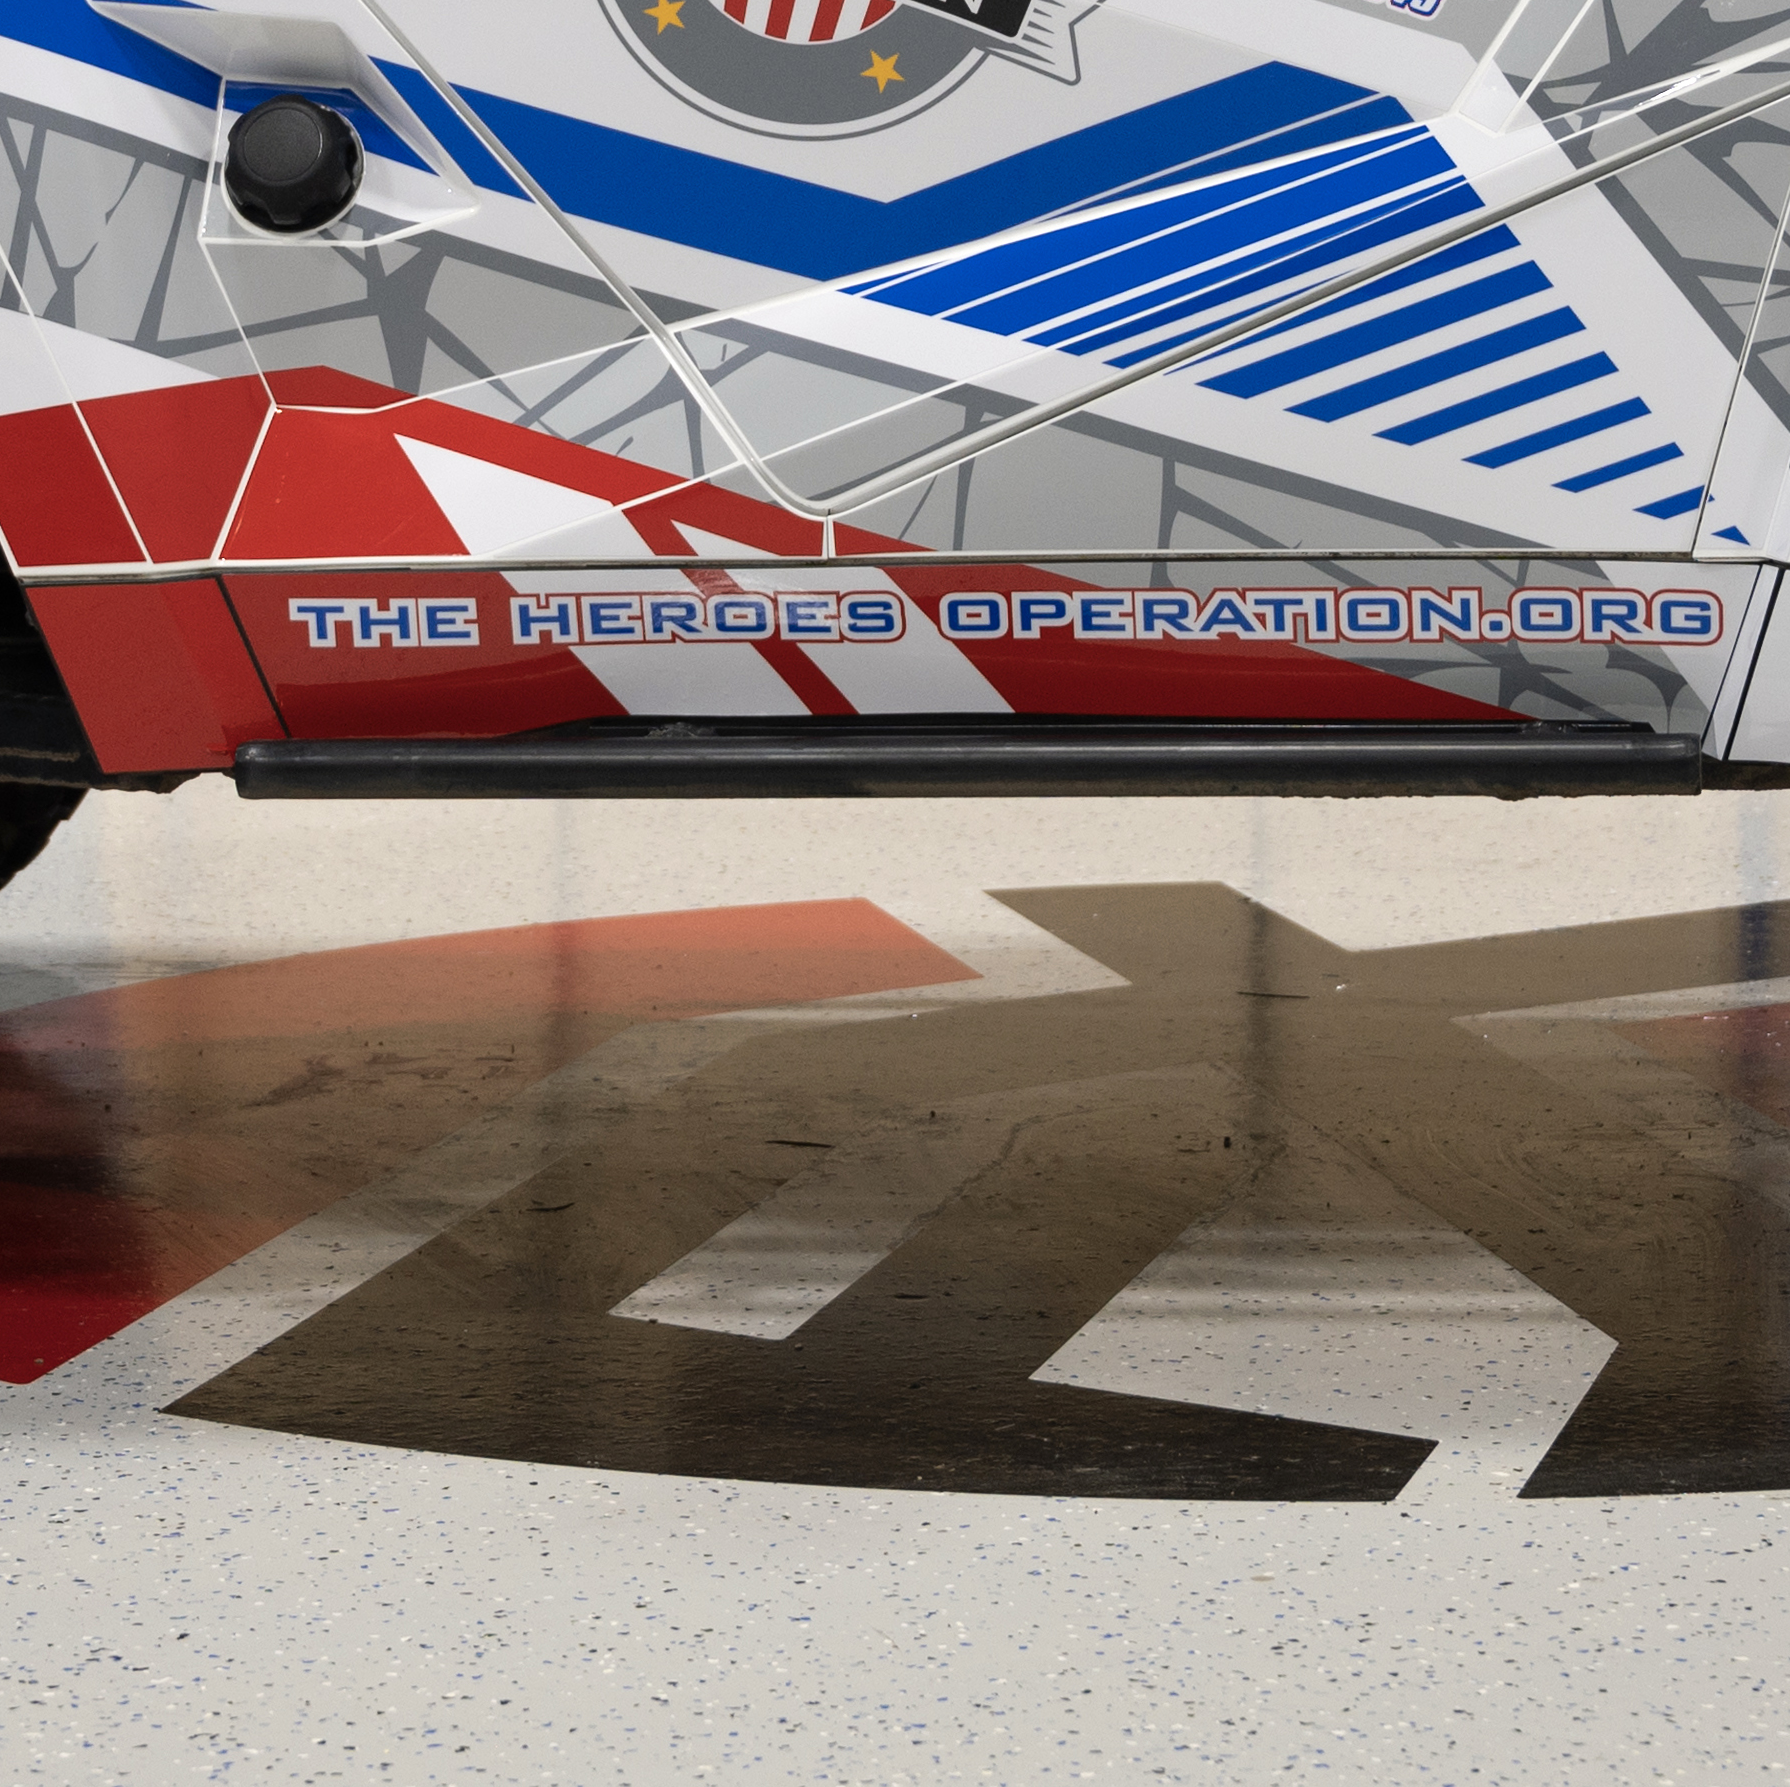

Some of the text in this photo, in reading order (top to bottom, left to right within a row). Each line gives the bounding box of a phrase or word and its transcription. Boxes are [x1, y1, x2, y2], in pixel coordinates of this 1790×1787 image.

[288, 585, 1724, 650] THE HEROES OPERATION.ORG
